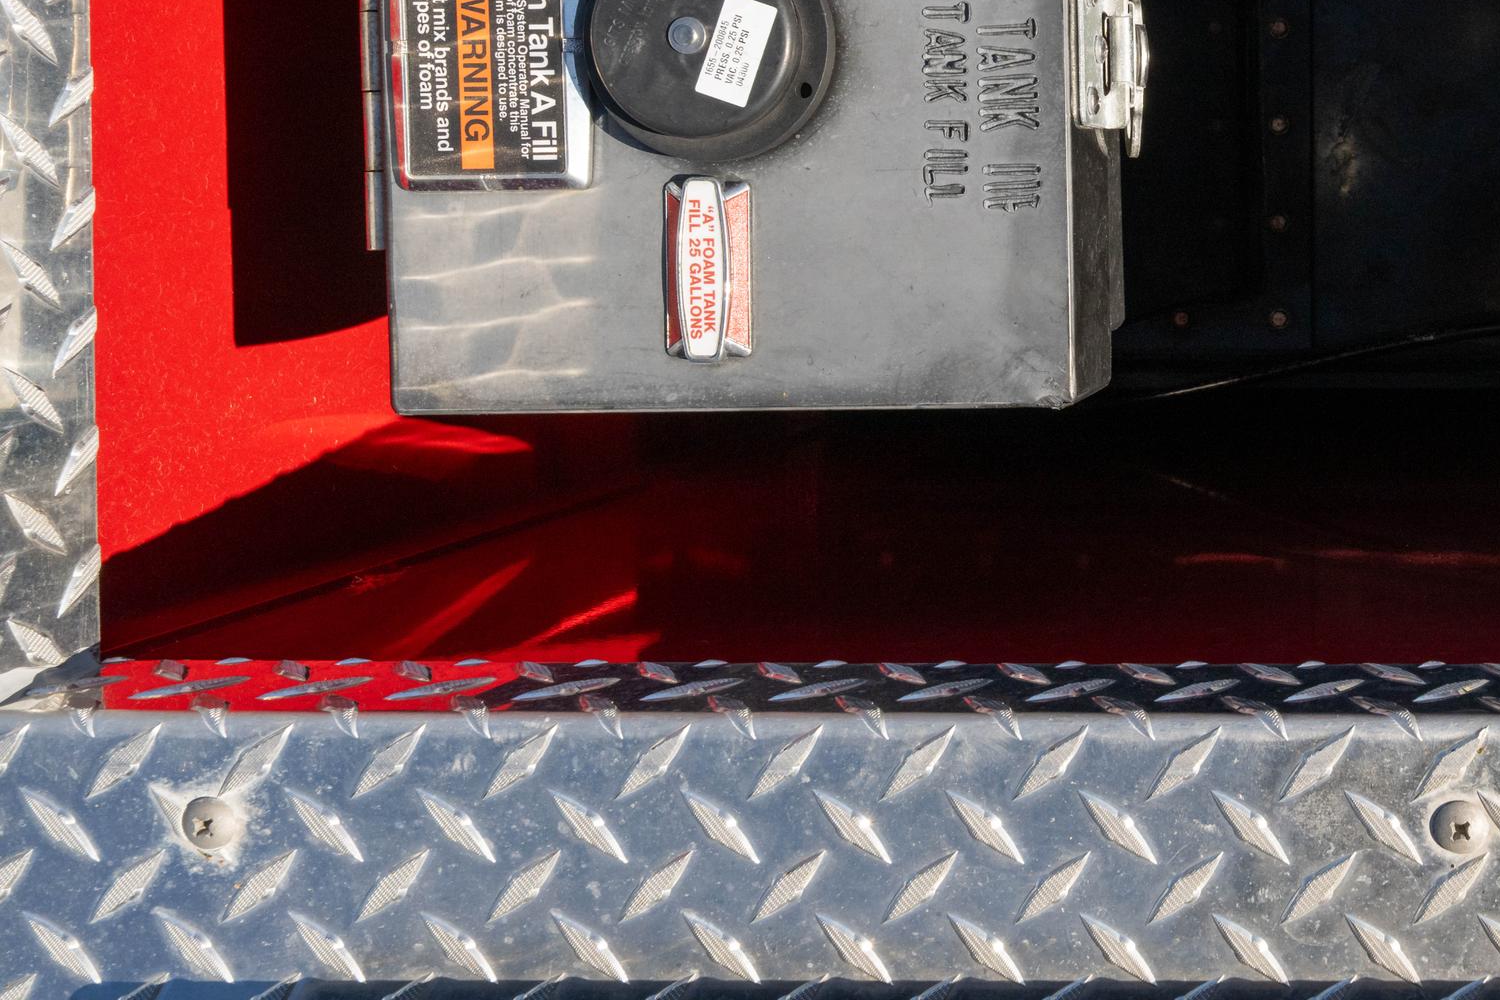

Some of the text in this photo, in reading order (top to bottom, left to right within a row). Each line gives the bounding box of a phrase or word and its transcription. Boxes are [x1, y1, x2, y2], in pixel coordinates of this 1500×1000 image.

[433, 8, 450, 42] mix
[496, 15, 506, 24] is
[506, 8, 517, 38] foam
[514, 0, 528, 42] System
[725, 29, 737, 48] 0.25
[732, 14, 742, 28] PSI
[416, 40, 434, 59] of
[494, 27, 507, 80] designed
[527, 17, 556, 86] Tank
[732, 45, 744, 63] 0.25
[738, 28, 749, 44] PSI
[922, 2, 972, 103] TANK
[418, 62, 435, 110] foam
[431, 47, 453, 112] brands
[498, 83, 508, 95] to
[507, 40, 519, 108] concentrate
[516, 45, 529, 96] Operator
[976, 18, 1041, 133] TANK
[498, 98, 507, 121] use.
[509, 111, 520, 132] this
[519, 99, 531, 140] Manual
[530, 91, 556, 115] A
[436, 117, 454, 151] and
[520, 142, 531, 159] for
[531, 121, 558, 160] Fill
[923, 120, 970, 206] FILL
[688, 200, 702, 339] FILL 25 GALLONS
[702, 206, 716, 332] “A” FOAM TANK
